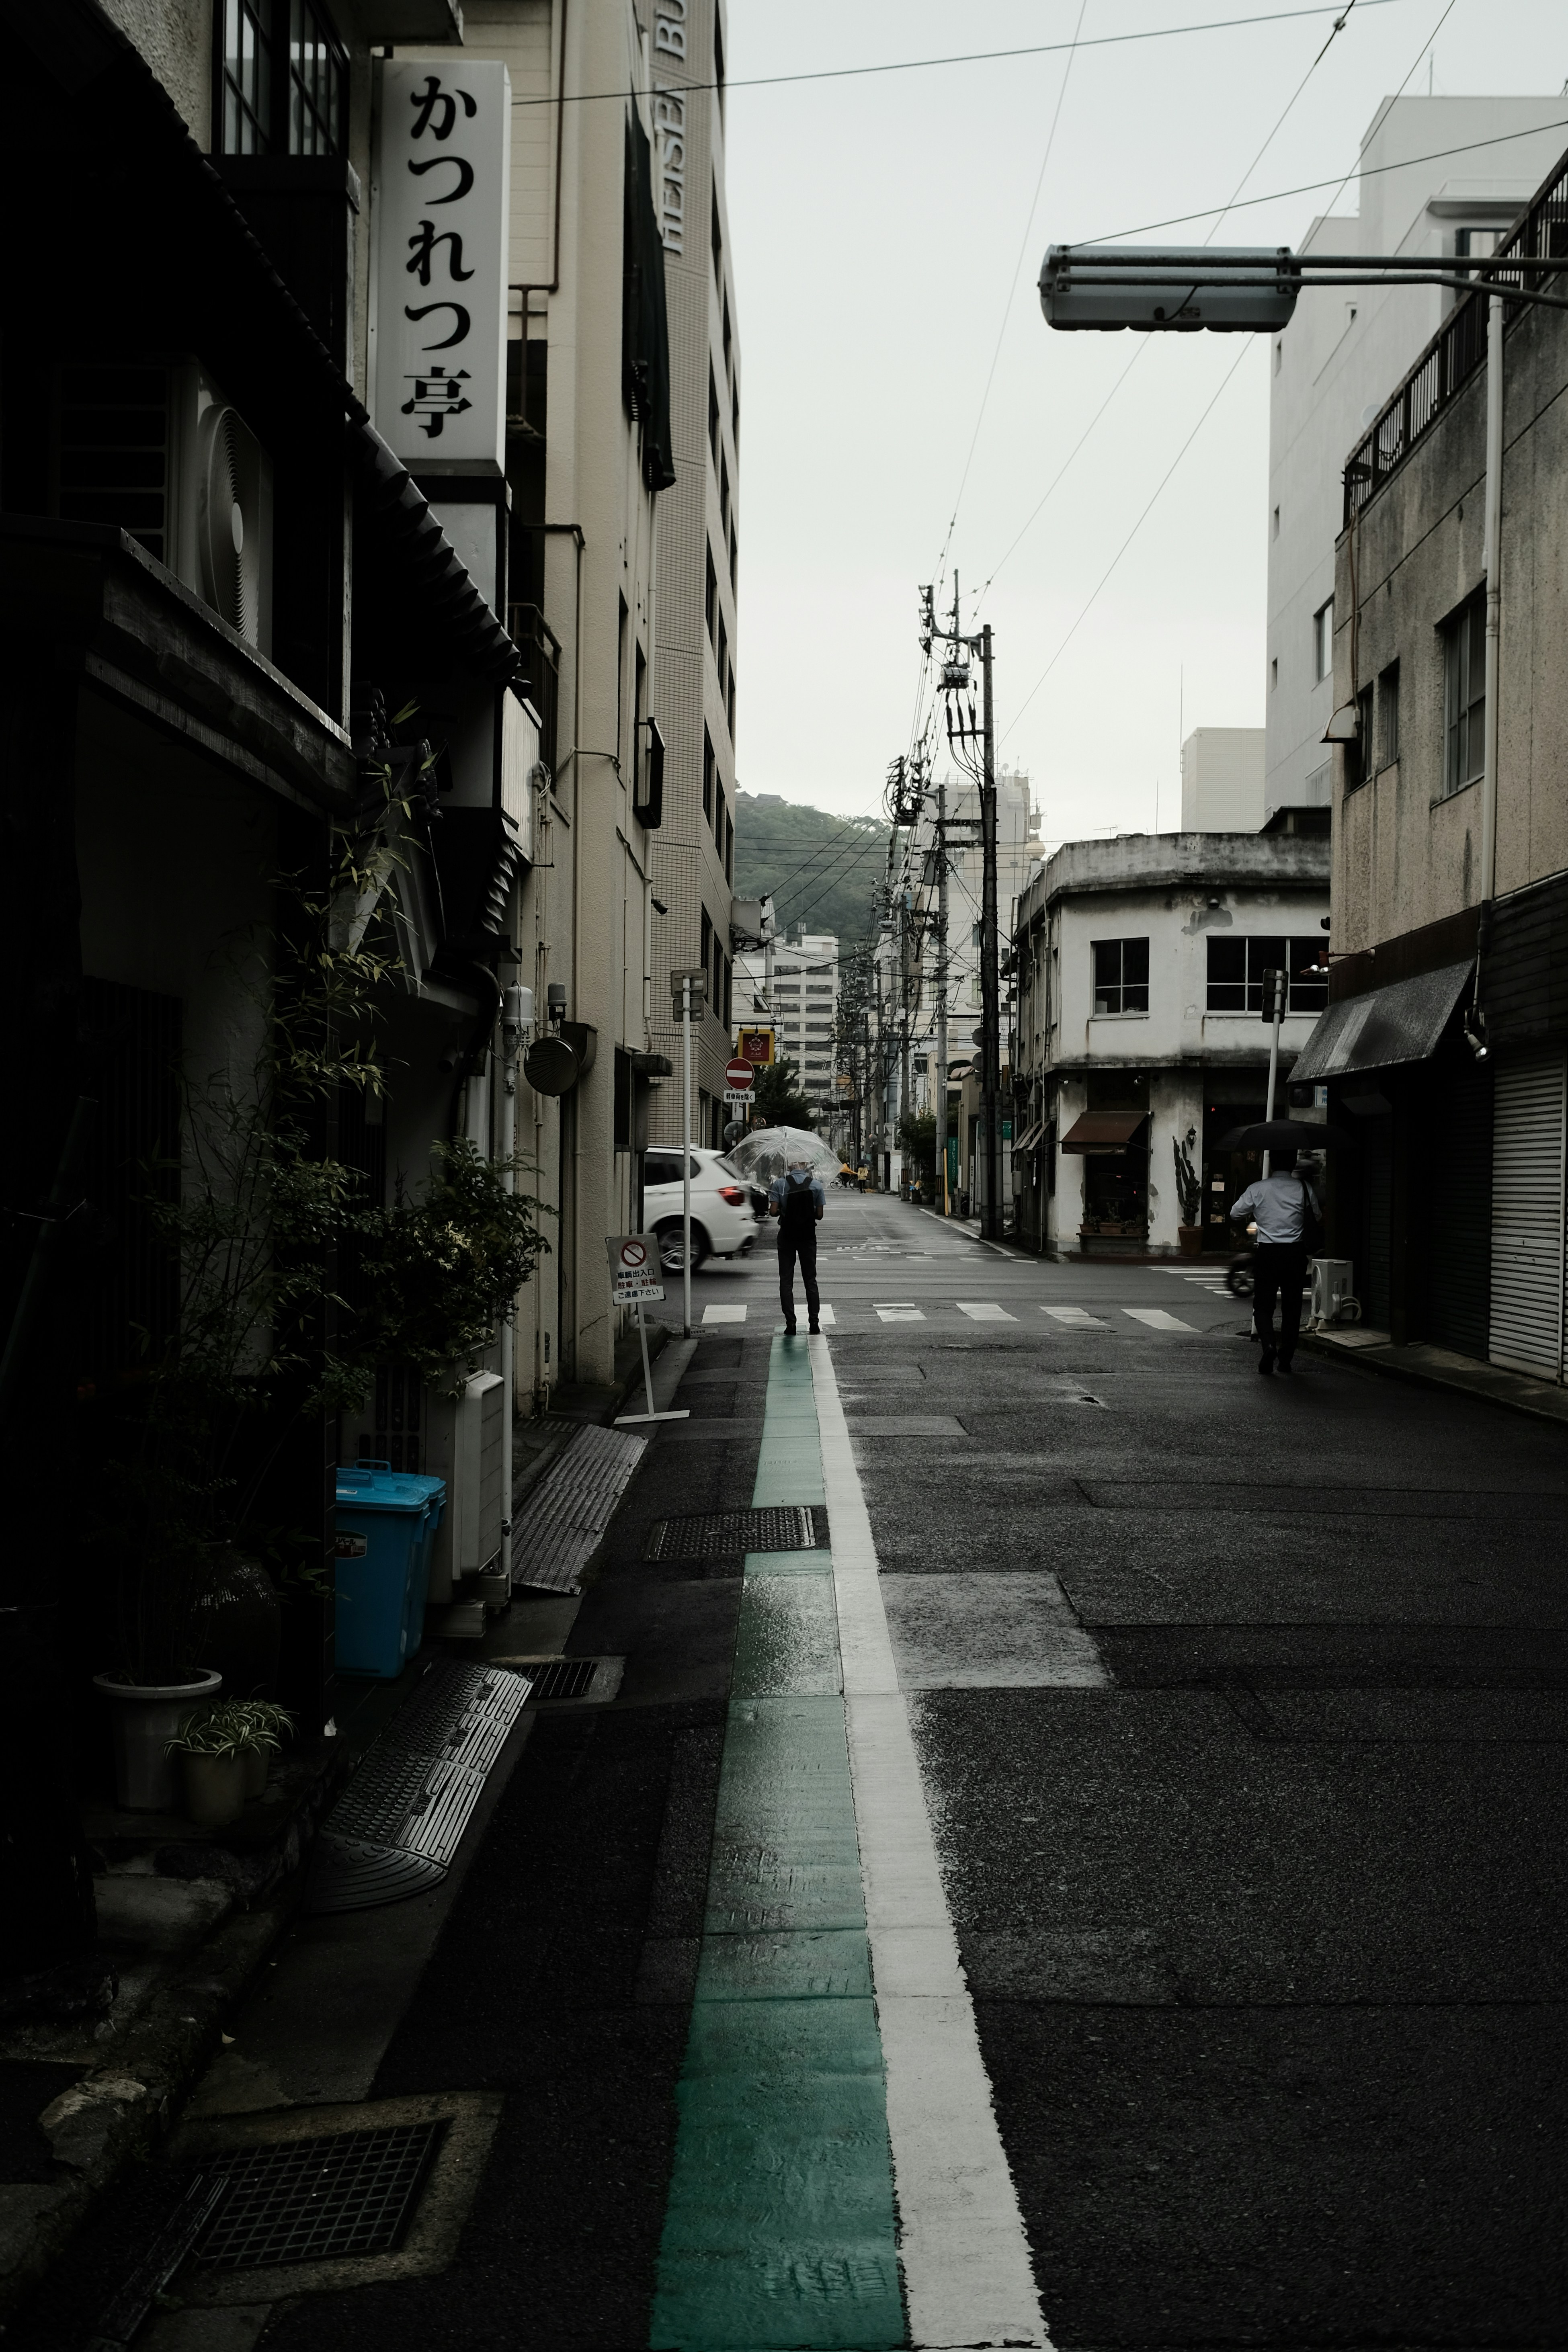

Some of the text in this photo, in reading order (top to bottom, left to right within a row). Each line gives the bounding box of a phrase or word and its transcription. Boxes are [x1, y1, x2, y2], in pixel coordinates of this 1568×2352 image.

[401, 76, 478, 439] かつれつ亭
[726, 1092, 752, 1100] 軽車両を除く
[618, 1288, 659, 1299] ご遠慮下さい
